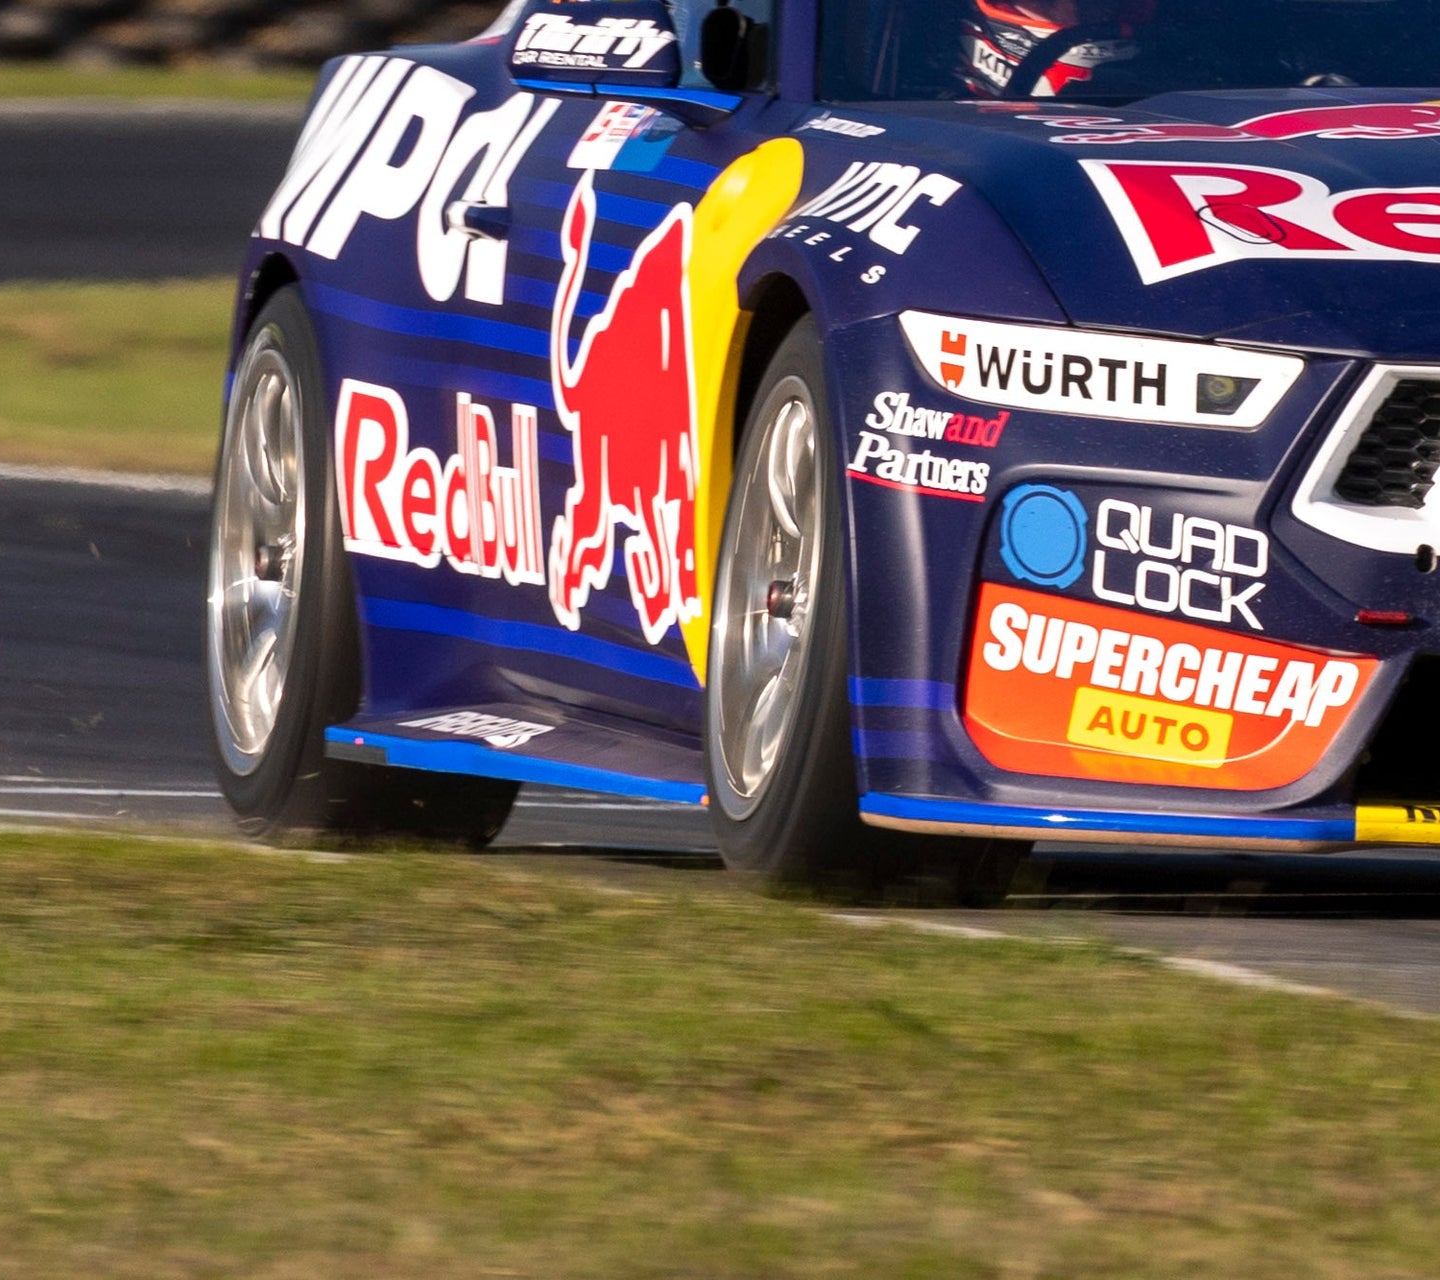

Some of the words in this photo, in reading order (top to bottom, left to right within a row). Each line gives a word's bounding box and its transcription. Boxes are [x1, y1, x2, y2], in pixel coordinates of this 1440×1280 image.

[515, 13, 677, 68] Thrifty
[976, 343, 1167, 406] WÜRTH
[847, 430, 990, 496] Partners
[1096, 498, 1270, 579] QUAD
[1092, 550, 1266, 630] LOCK
[982, 603, 1359, 728] SUPERCHEAP
[1086, 705, 1210, 752] AUTO
